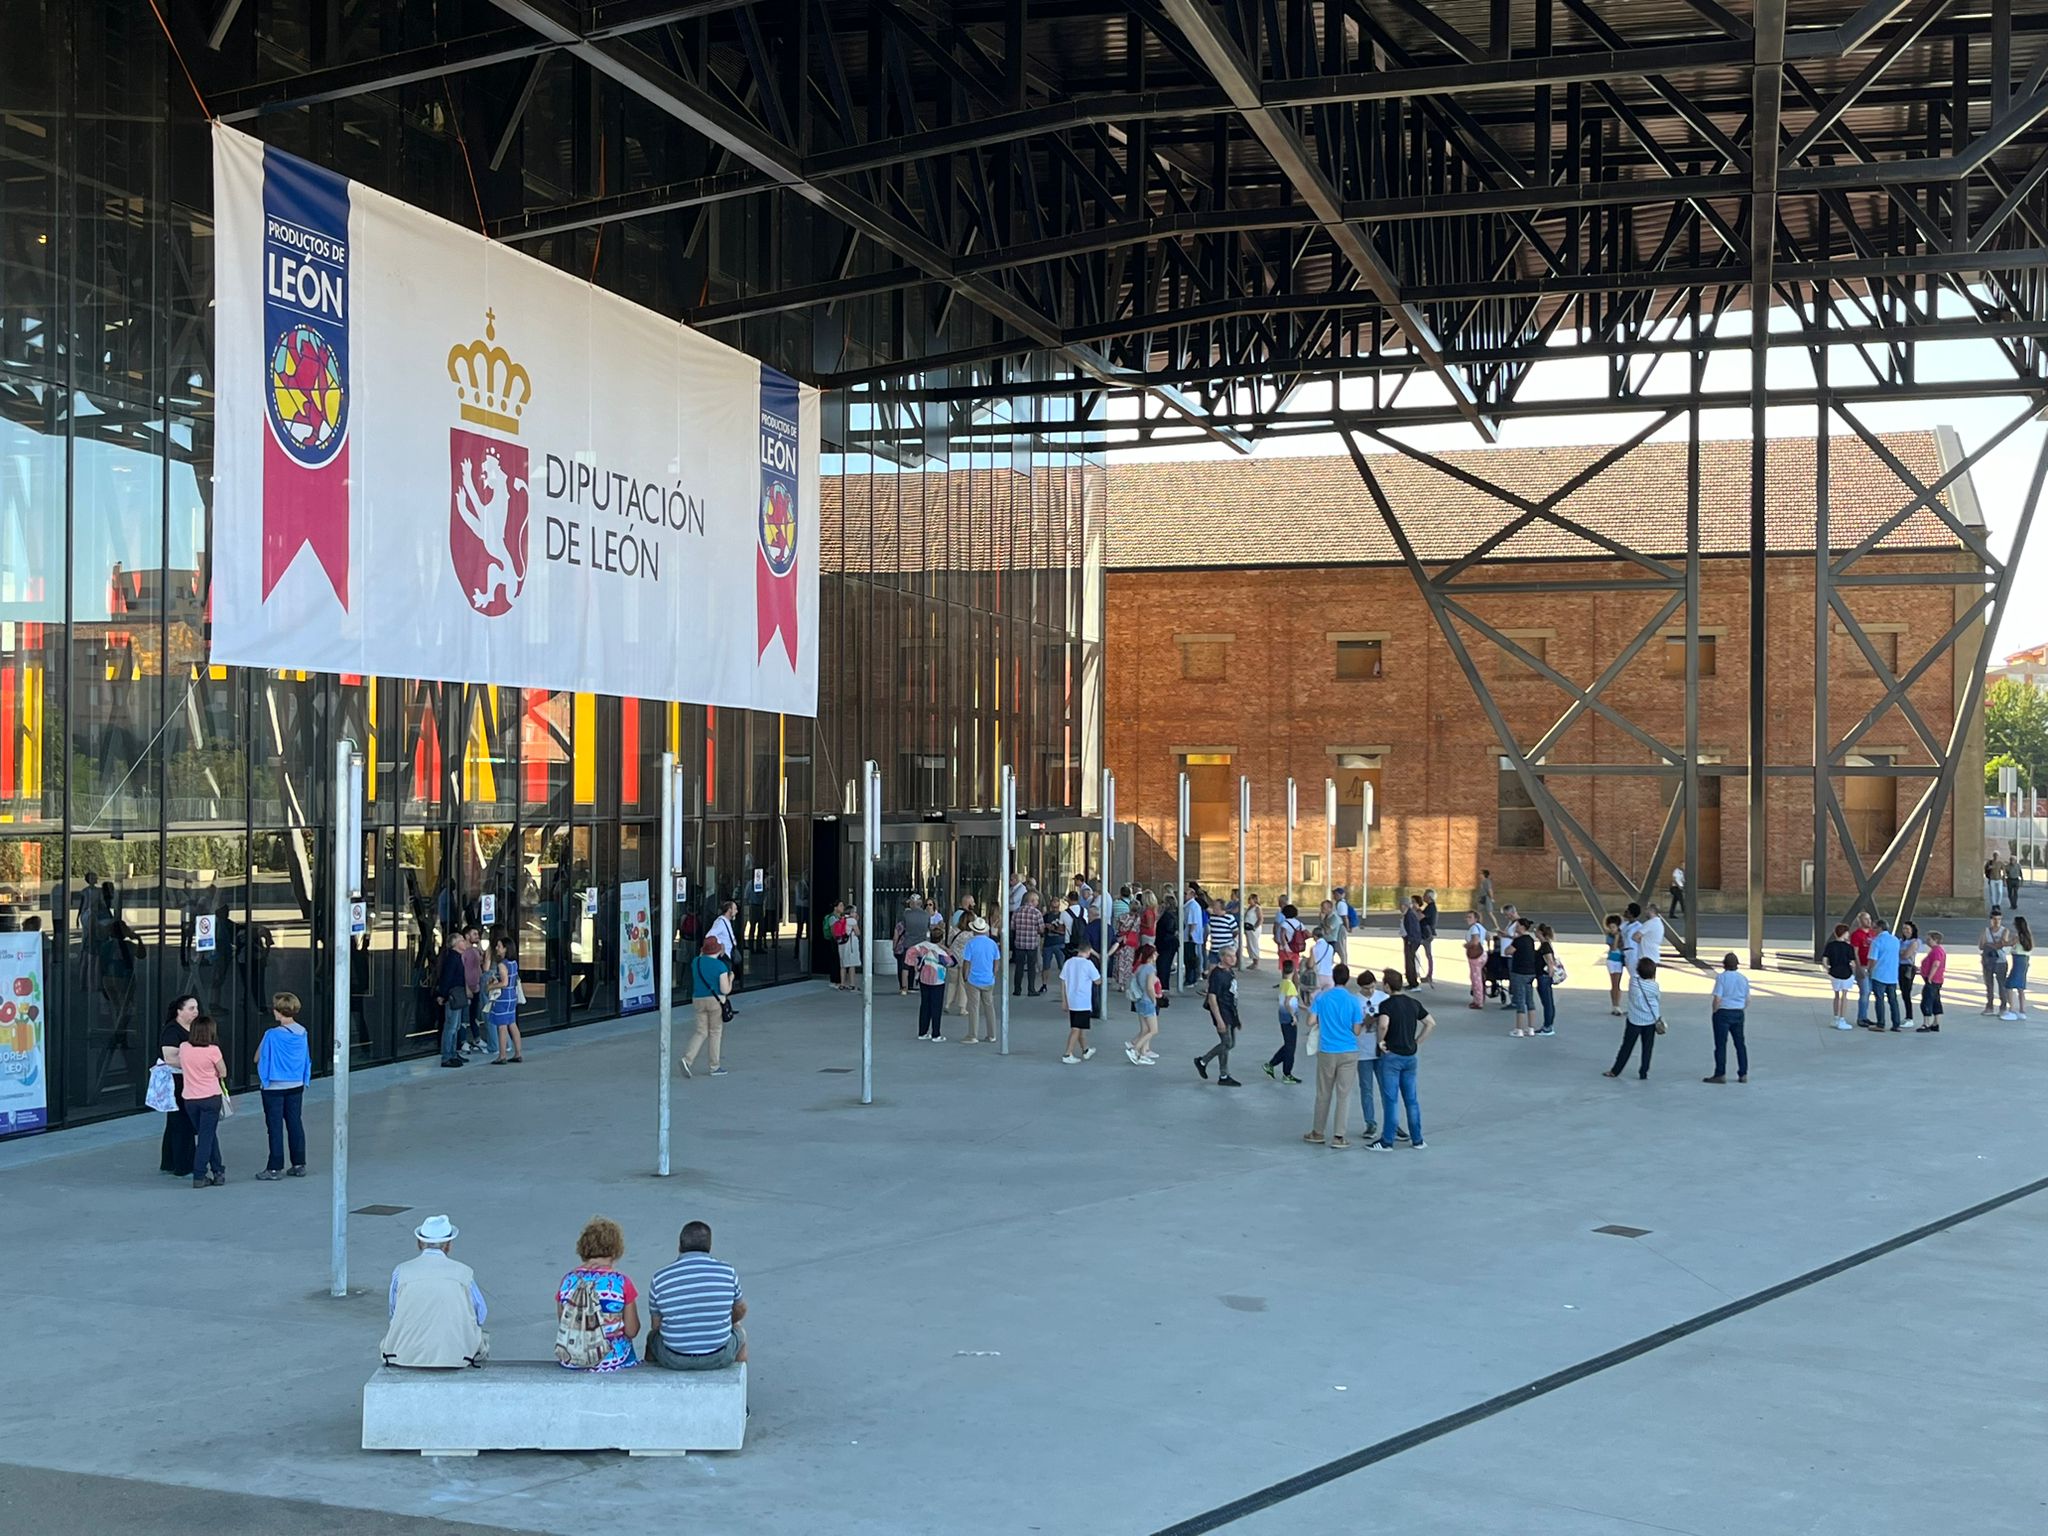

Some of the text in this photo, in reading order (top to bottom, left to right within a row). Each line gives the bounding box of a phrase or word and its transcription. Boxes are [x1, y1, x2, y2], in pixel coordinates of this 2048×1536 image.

[268, 220, 345, 263] PRODUCTOS DE
[268, 252, 343, 319] LEÓN
[762, 413, 797, 438] PRODUCTOS DE
[761, 432, 796, 475] LEÓN
[546, 453, 704, 536] DIPUTACIÓN
[546, 516, 658, 581] DE LEÓN
